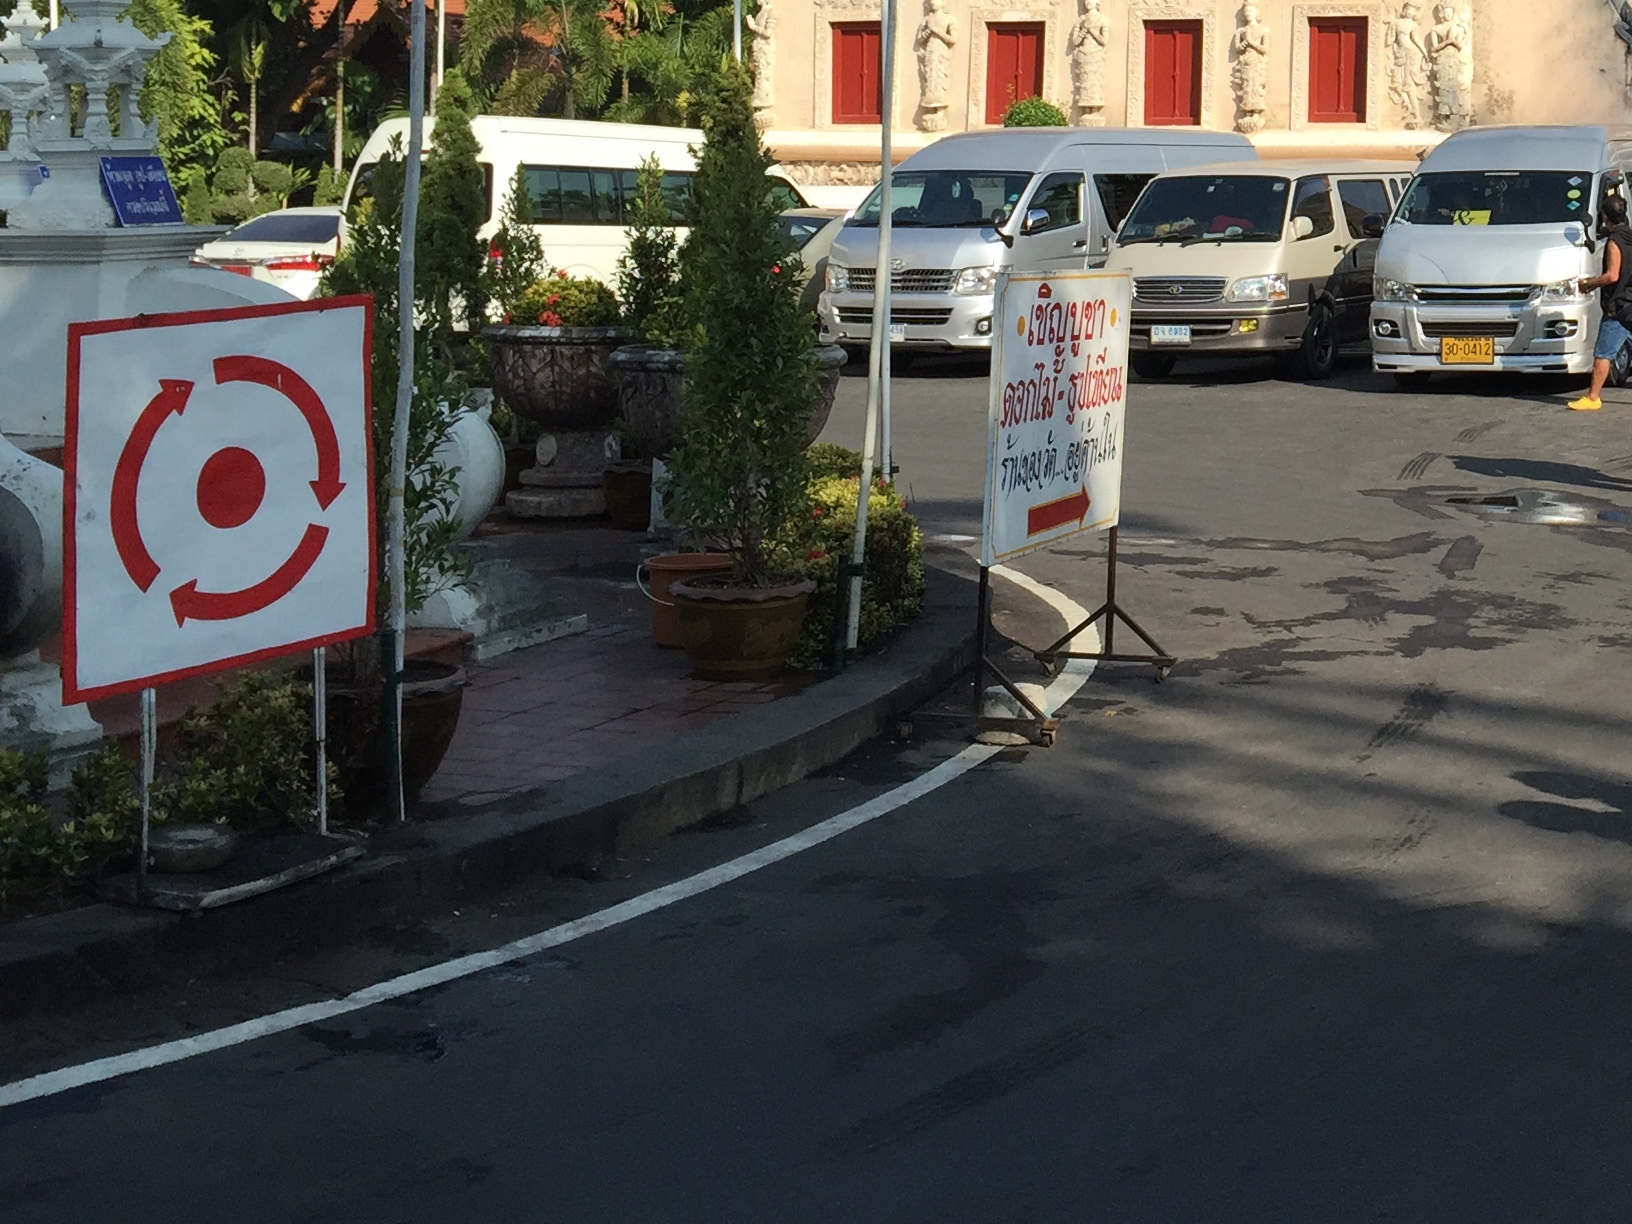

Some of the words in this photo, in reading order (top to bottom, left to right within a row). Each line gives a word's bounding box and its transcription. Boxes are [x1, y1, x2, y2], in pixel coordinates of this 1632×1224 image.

[1027, 282, 1107, 358] เชิญบูชา
[1445, 342, 1491, 356] 30-0412
